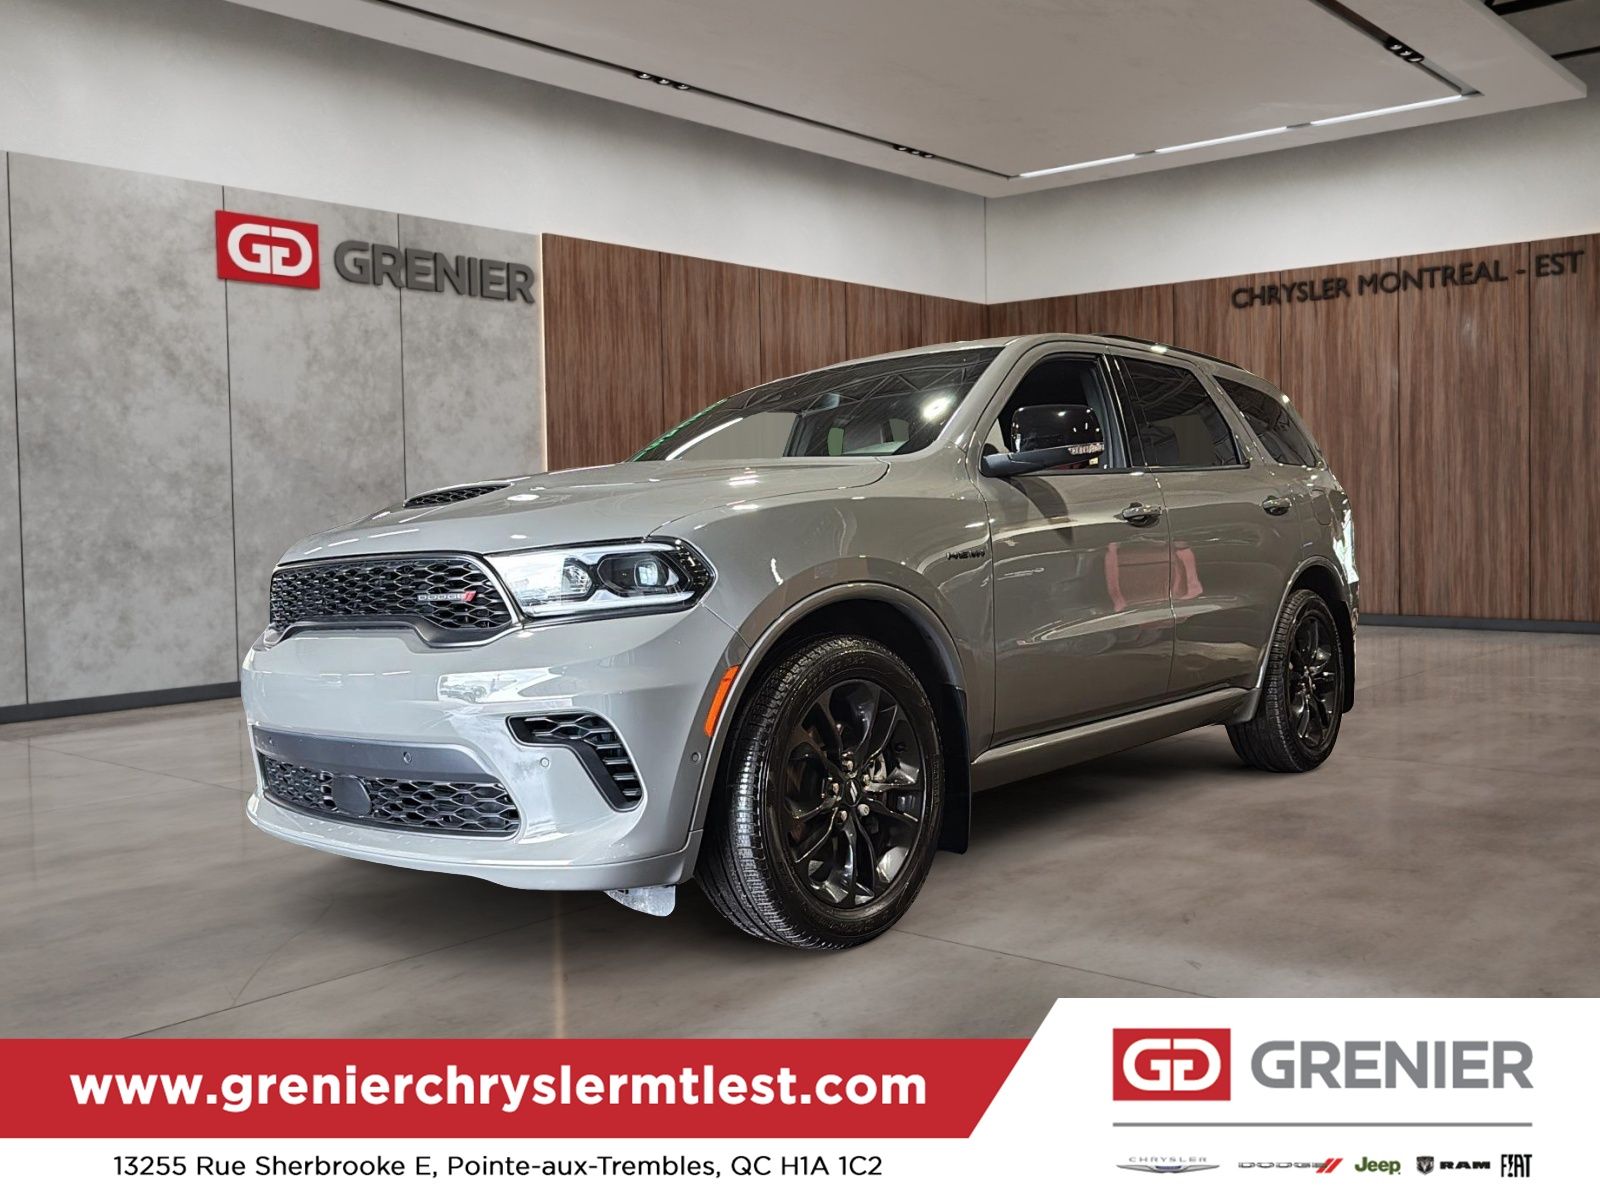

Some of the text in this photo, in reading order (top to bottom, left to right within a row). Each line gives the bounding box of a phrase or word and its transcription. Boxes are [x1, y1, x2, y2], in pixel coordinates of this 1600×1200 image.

[333, 239, 536, 304] GRENIER
[1231, 277, 1349, 309] CHRYSLER
[1357, 260, 1509, 296] MONTREAL
[1535, 250, 1585, 278] EST
